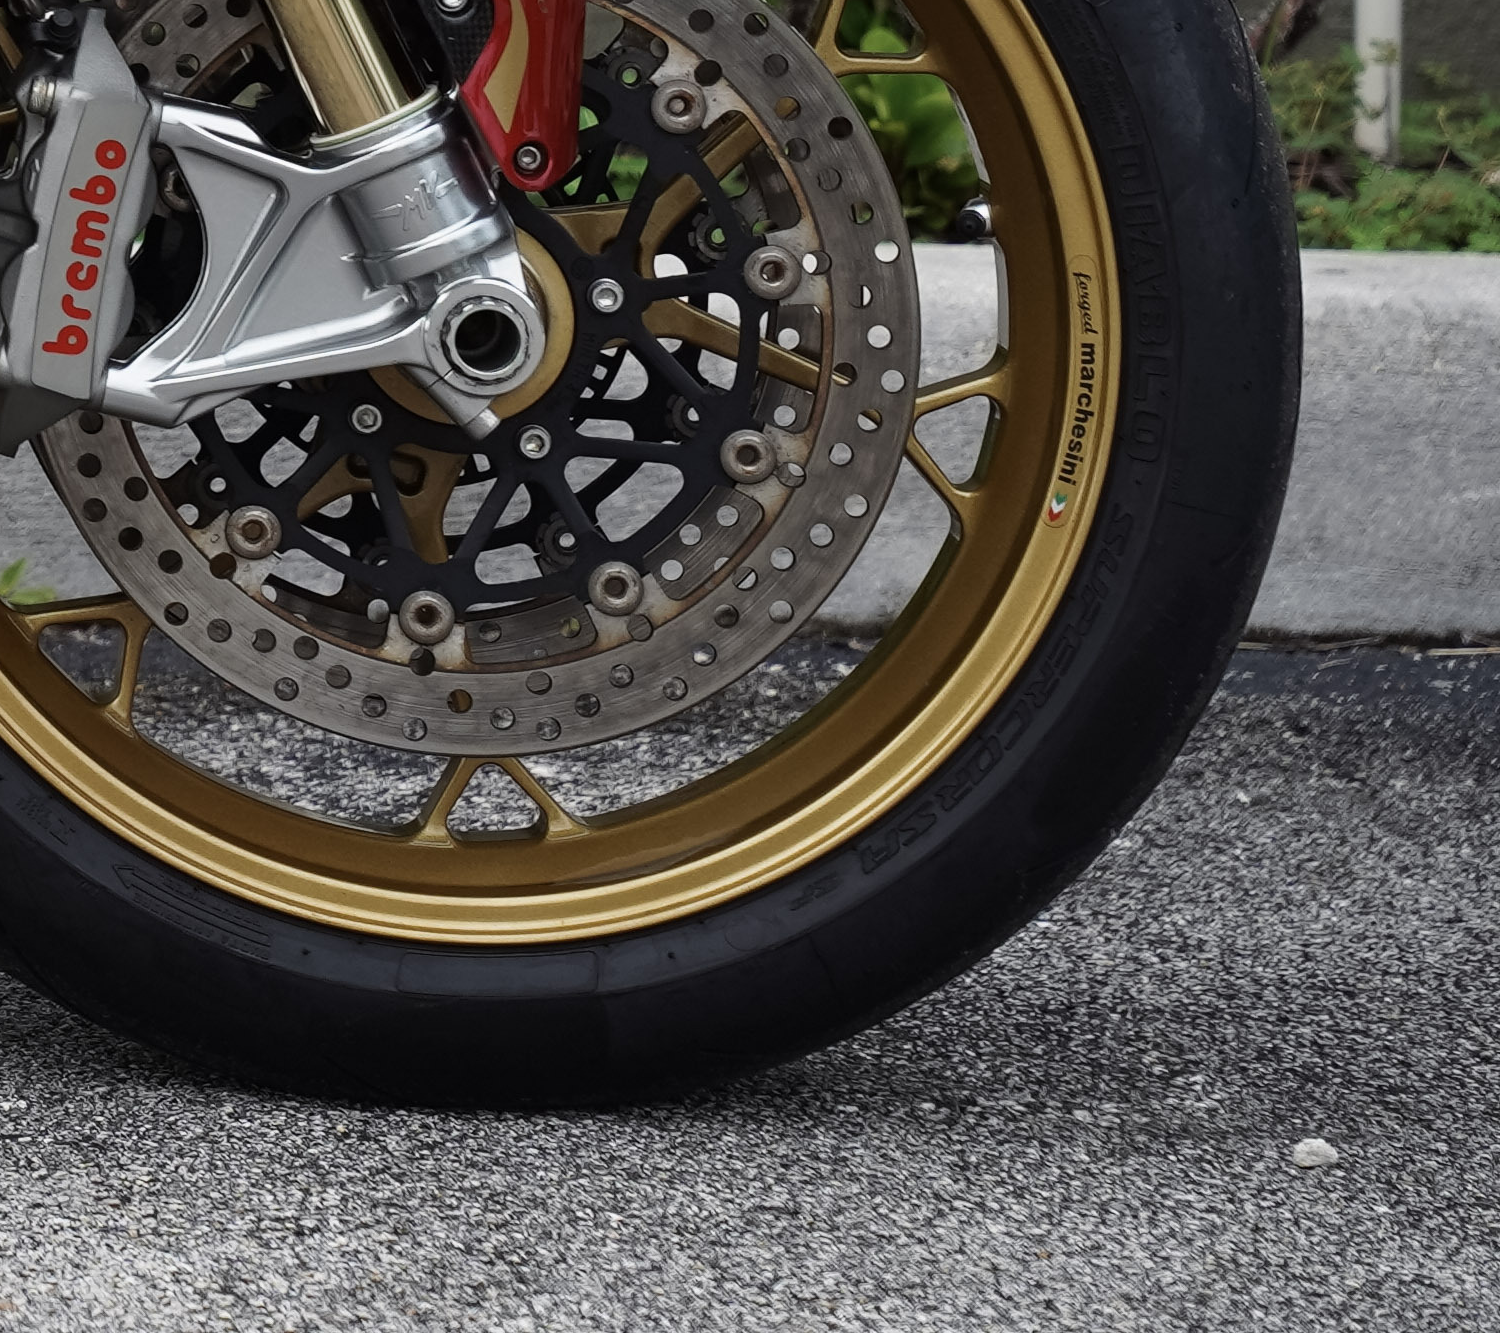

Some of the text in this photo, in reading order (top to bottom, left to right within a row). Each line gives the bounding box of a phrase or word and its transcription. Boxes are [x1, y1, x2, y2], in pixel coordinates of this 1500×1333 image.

[42, 139, 127, 356] brembo
[1058, 270, 1099, 487] forged marchesini
